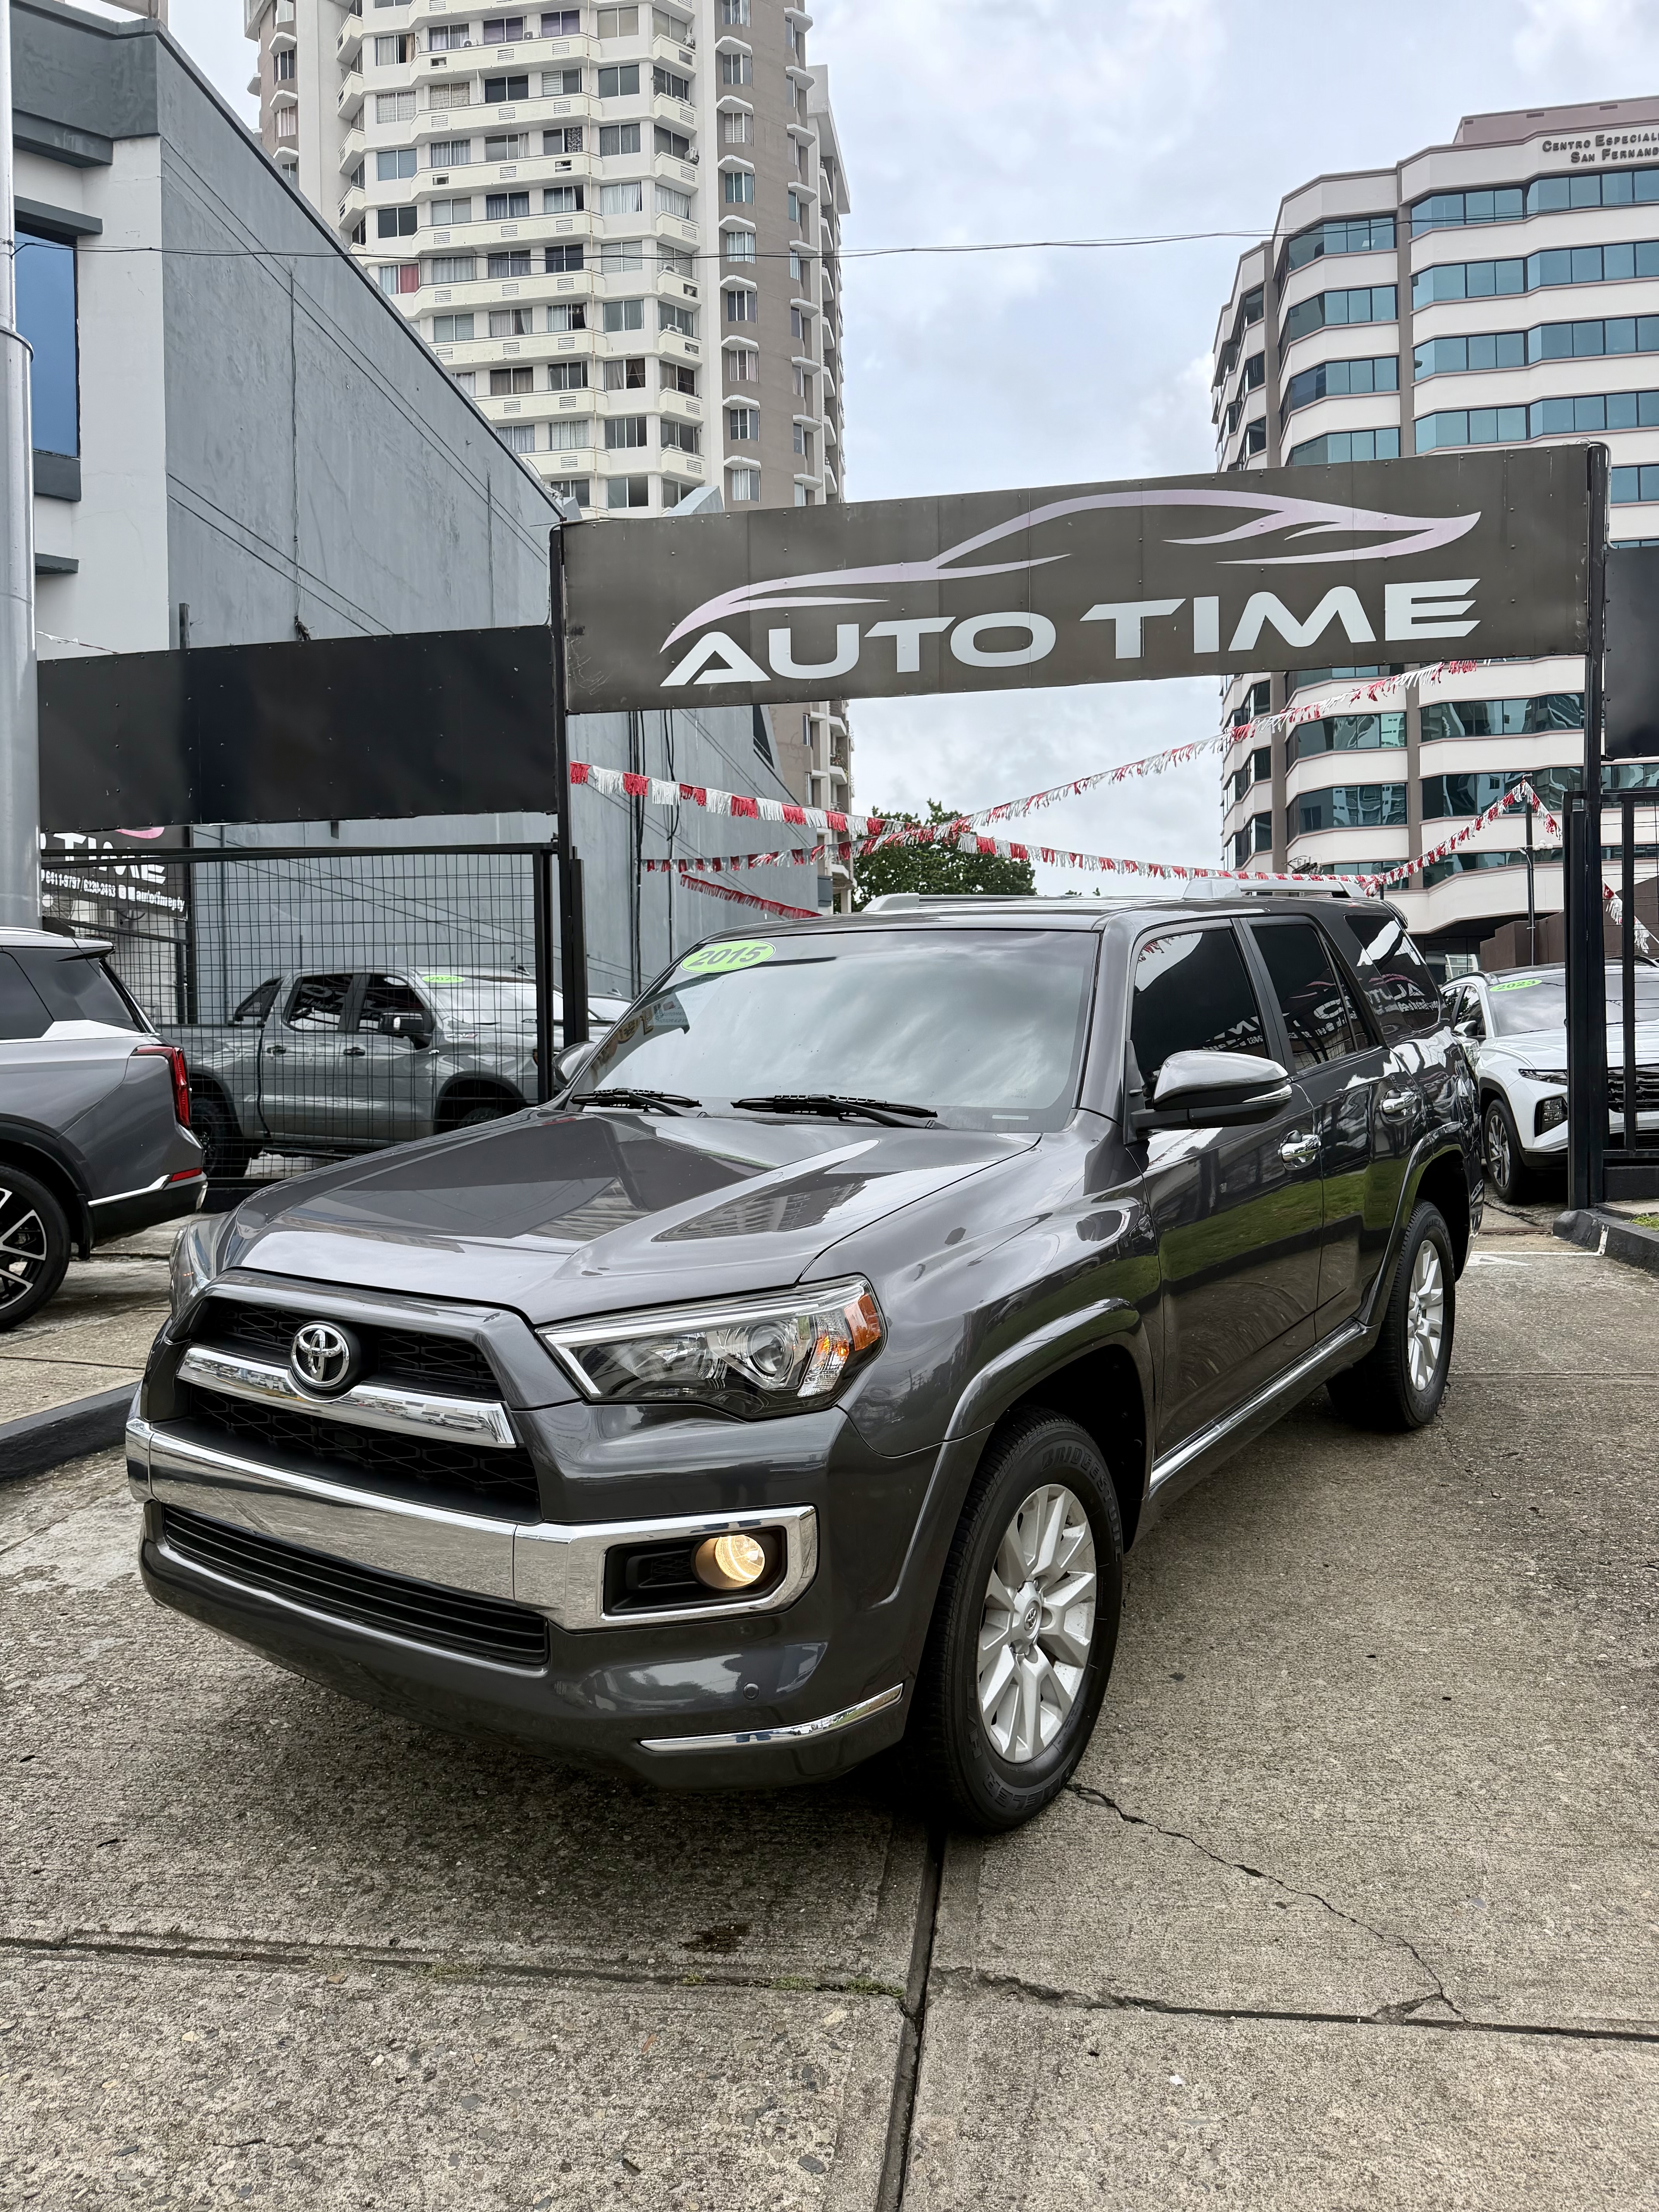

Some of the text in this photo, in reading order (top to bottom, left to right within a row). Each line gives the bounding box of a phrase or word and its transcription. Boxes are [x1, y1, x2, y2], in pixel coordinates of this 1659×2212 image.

[1542, 132, 1659, 152] CENTRO ESPECIAL
[1571, 151, 1595, 163] SAN
[659, 578, 1481, 687] AUTO TIME
[687, 946, 769, 967] 2015
[1496, 980, 1536, 990] 2023
